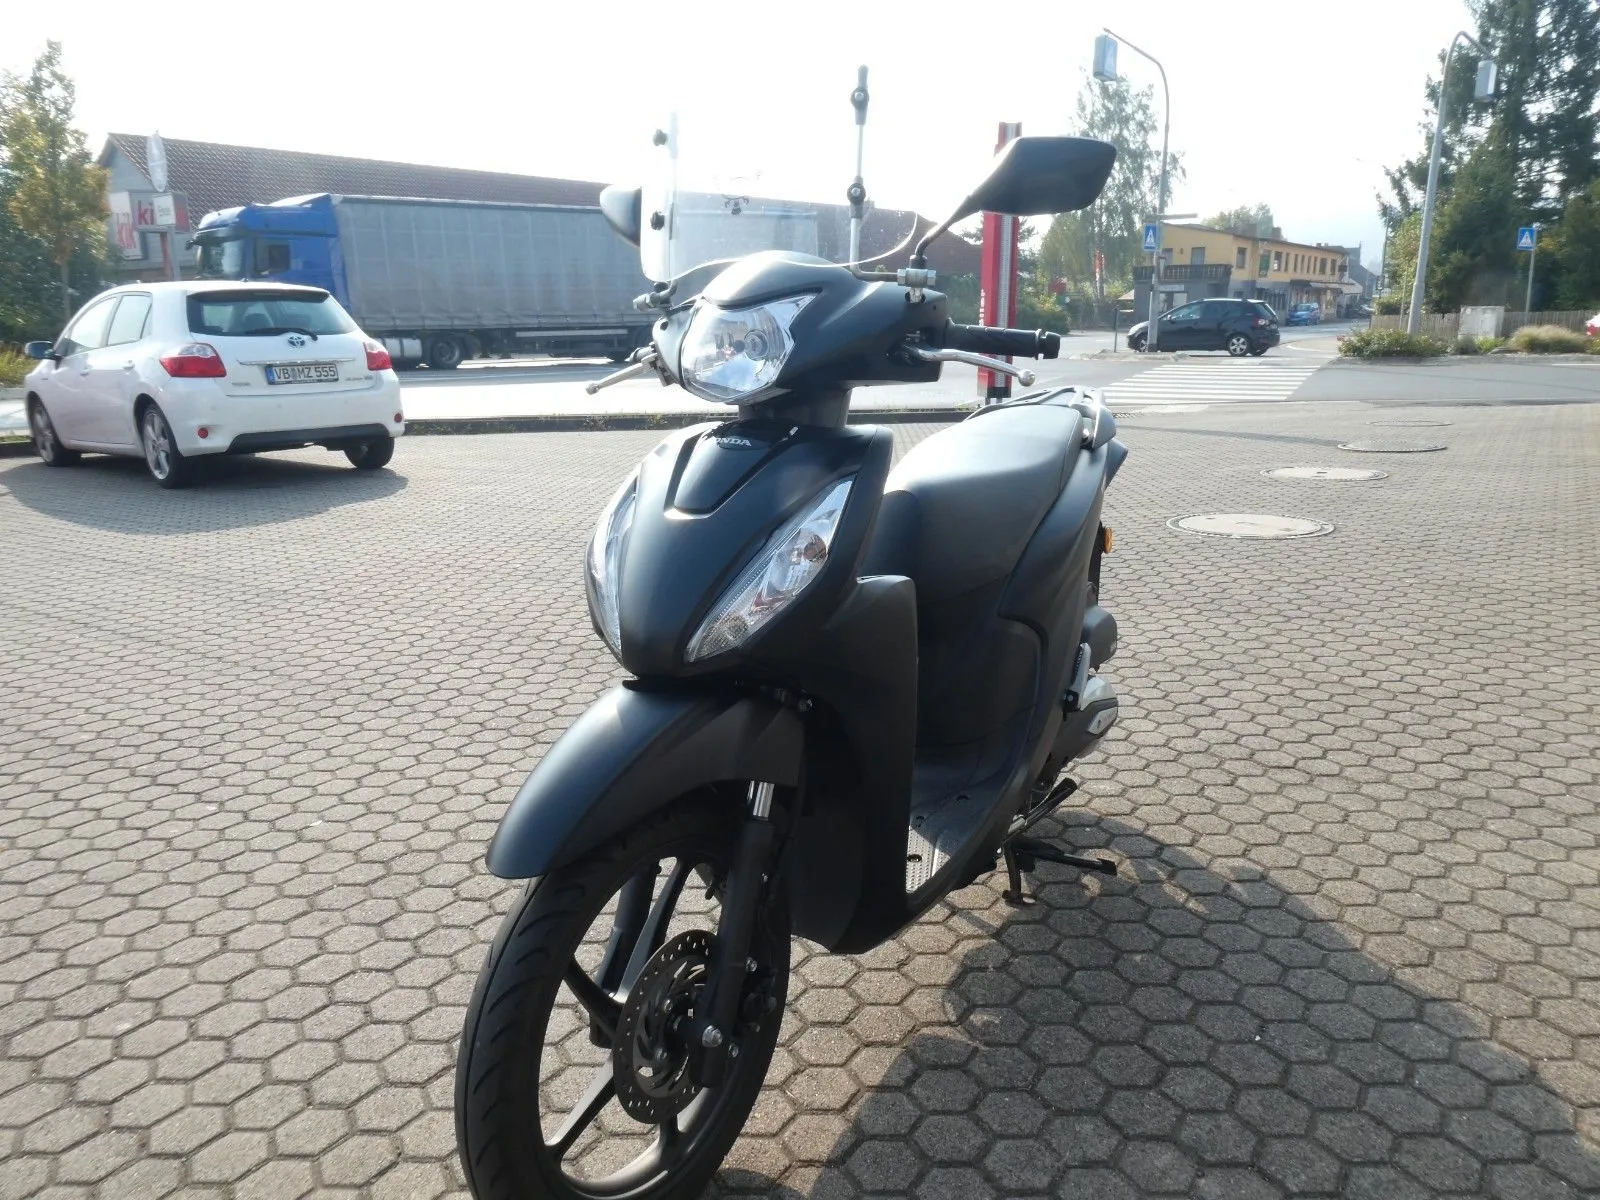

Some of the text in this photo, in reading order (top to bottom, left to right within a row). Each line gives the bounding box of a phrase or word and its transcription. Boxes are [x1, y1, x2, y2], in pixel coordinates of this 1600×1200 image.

[137, 200, 155, 225] ki
[274, 367, 290, 380] VB
[297, 366, 313, 379] MZ
[314, 365, 336, 378] 555
[714, 437, 752, 446] ONDA
